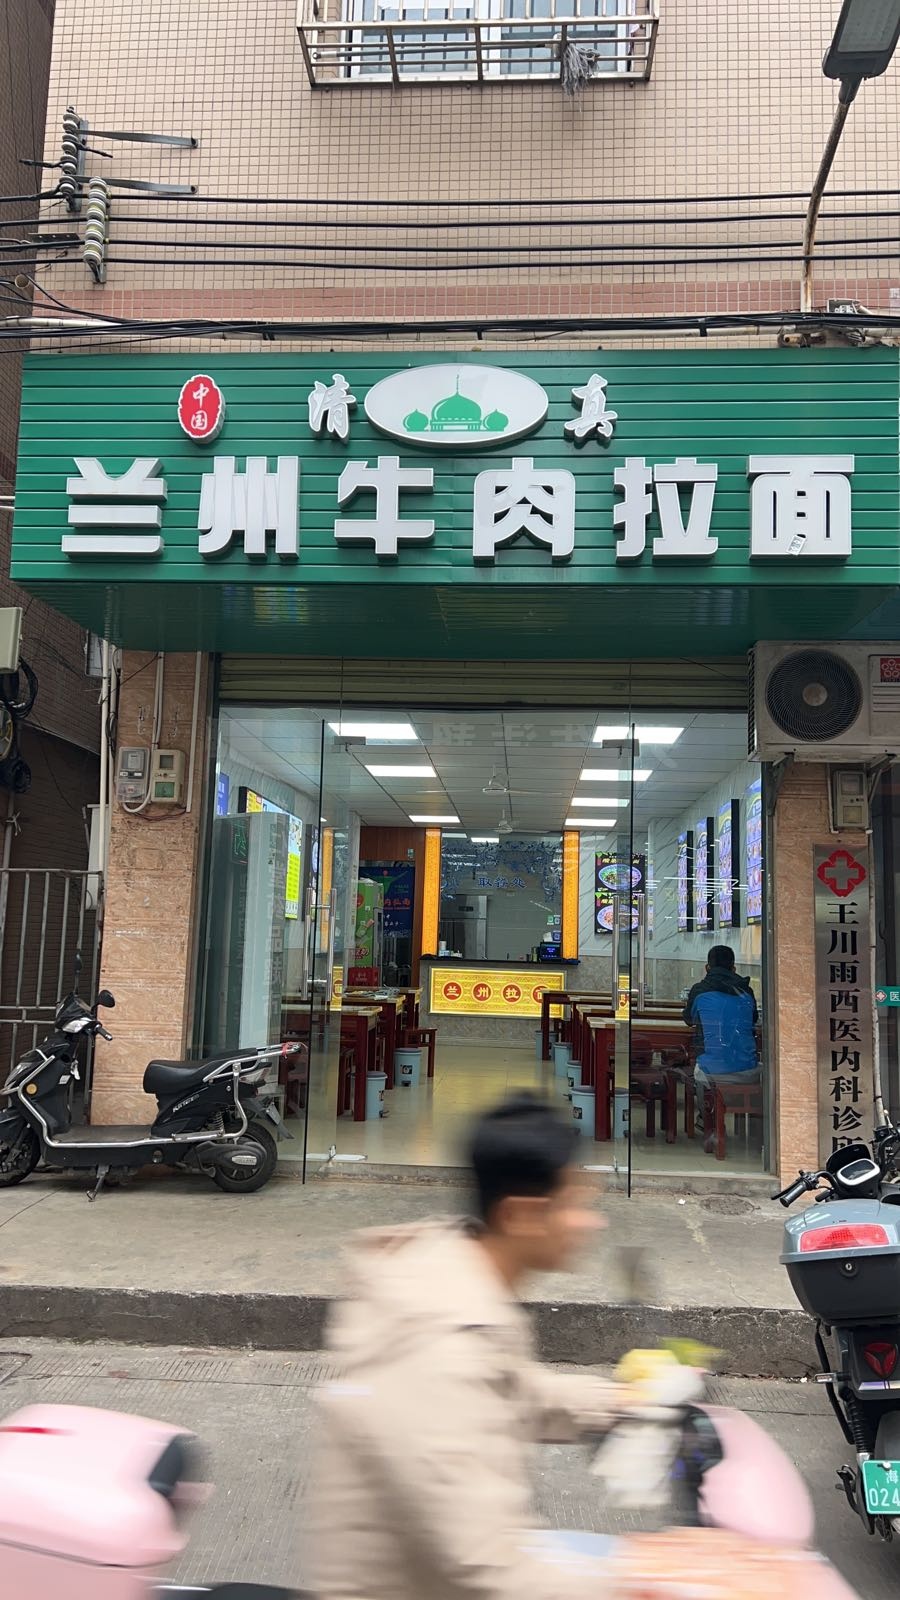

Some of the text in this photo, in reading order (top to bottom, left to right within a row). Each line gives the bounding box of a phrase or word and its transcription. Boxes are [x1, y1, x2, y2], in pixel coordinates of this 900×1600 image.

[191, 383, 210, 430] 中国
[308, 374, 617, 439] 清 真
[61, 455, 855, 558] 兰州牛肉拉面
[889, 991, 900, 1002] 医
